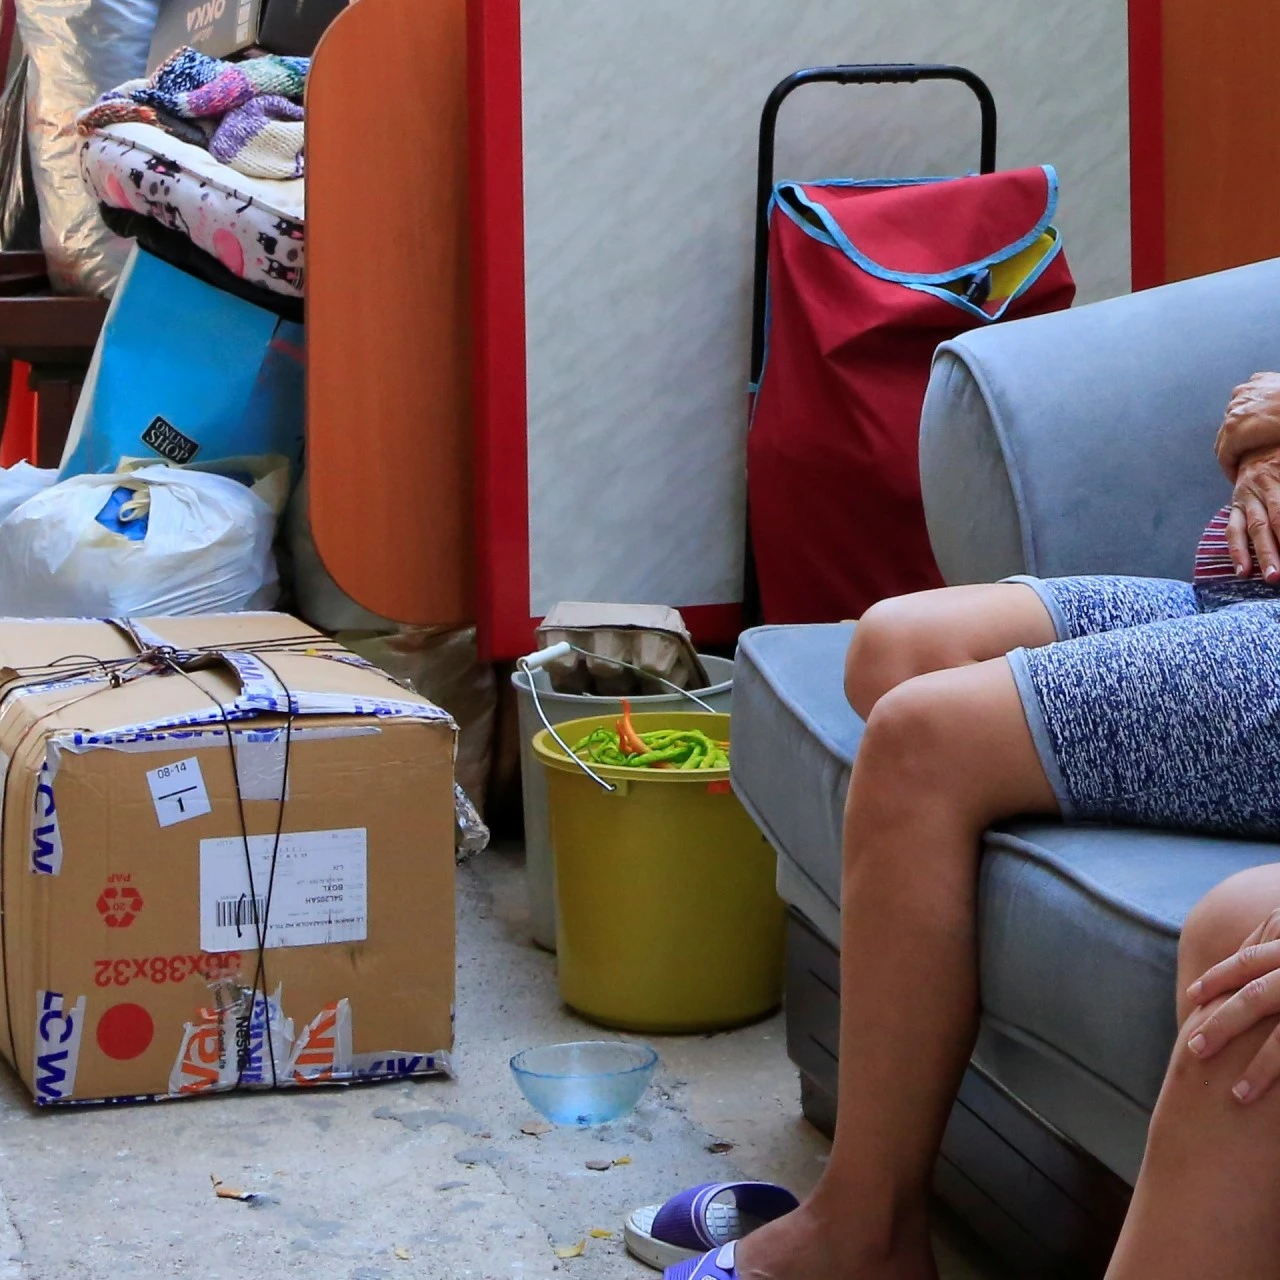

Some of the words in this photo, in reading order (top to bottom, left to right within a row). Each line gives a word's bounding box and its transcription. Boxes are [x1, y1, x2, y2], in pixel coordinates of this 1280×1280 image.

[146, 429, 190, 461] SHOP
[154, 420, 193, 450] ONLINE
[157, 762, 188, 779] 08-14
[177, 796, 185, 813] 1
